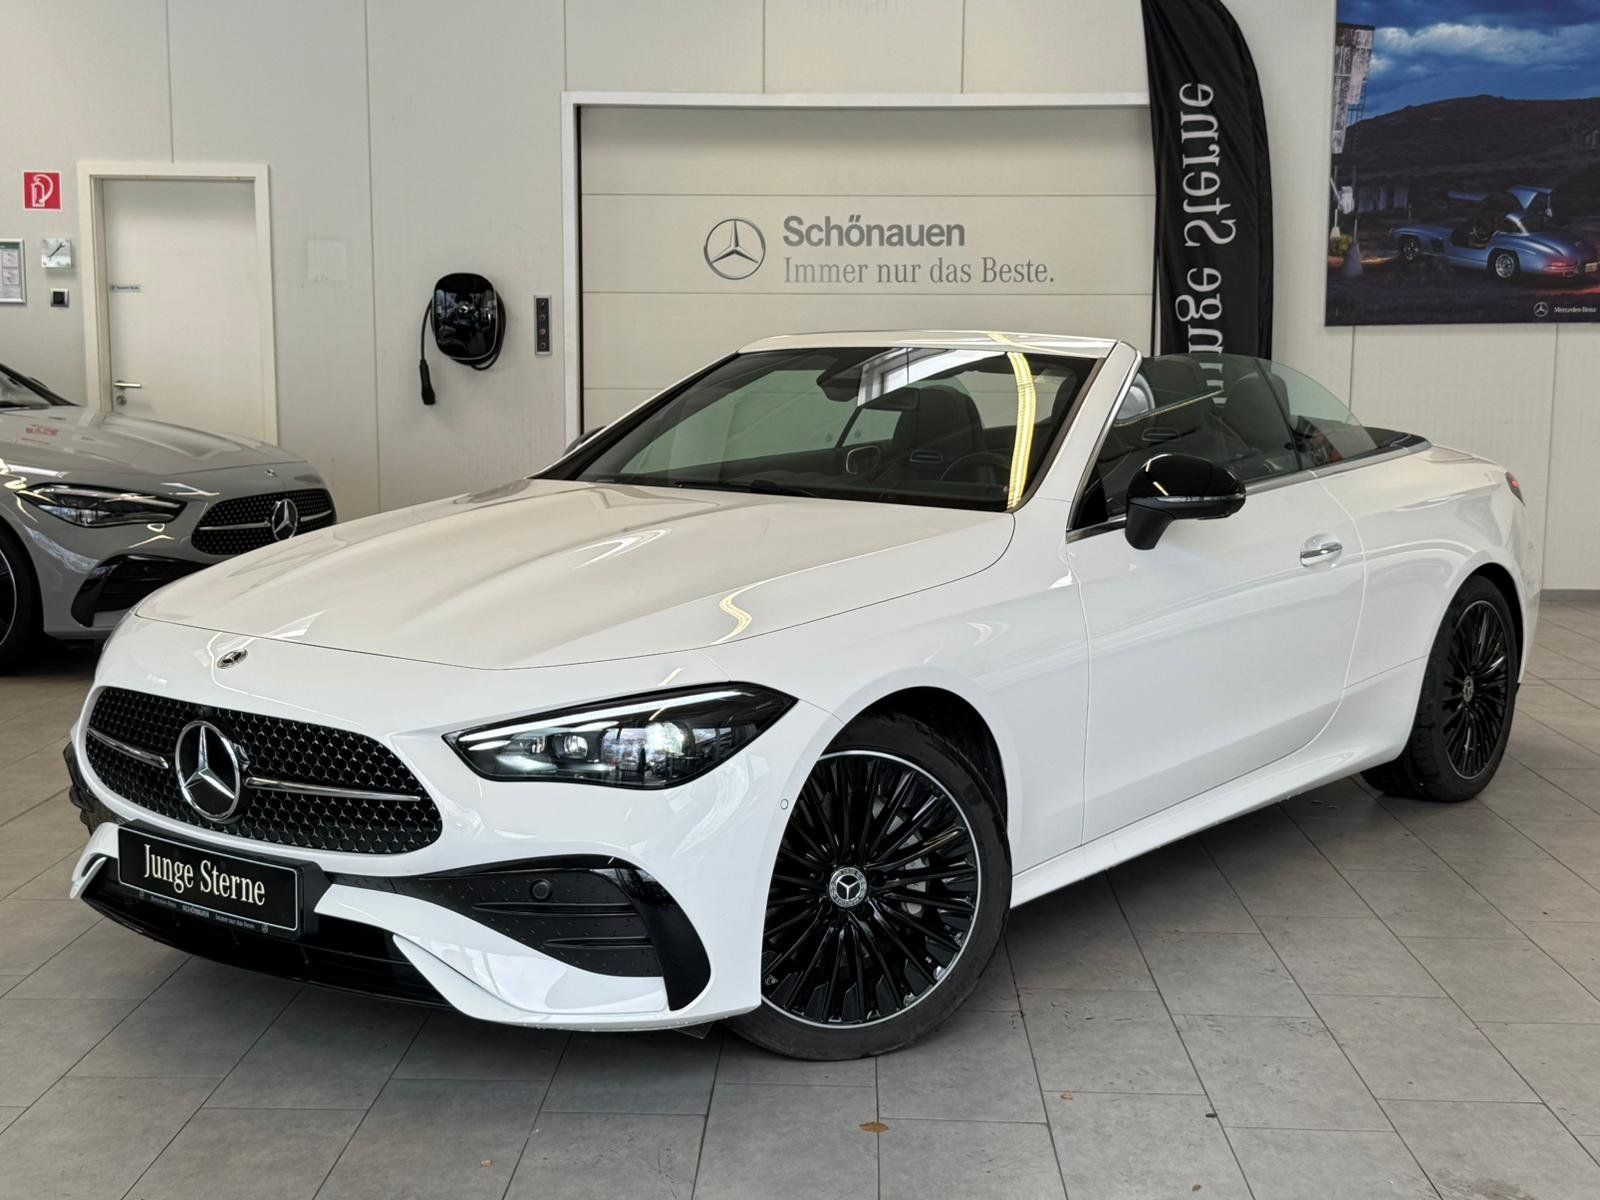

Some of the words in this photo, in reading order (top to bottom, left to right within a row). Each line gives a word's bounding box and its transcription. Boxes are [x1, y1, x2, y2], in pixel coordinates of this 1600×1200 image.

[783, 256, 868, 283] Immer
[876, 261, 922, 283] nur
[929, 257, 972, 283] das
[980, 256, 1055, 283] Beste.
[143, 843, 194, 894] Junge
[199, 859, 266, 906] Sterne
